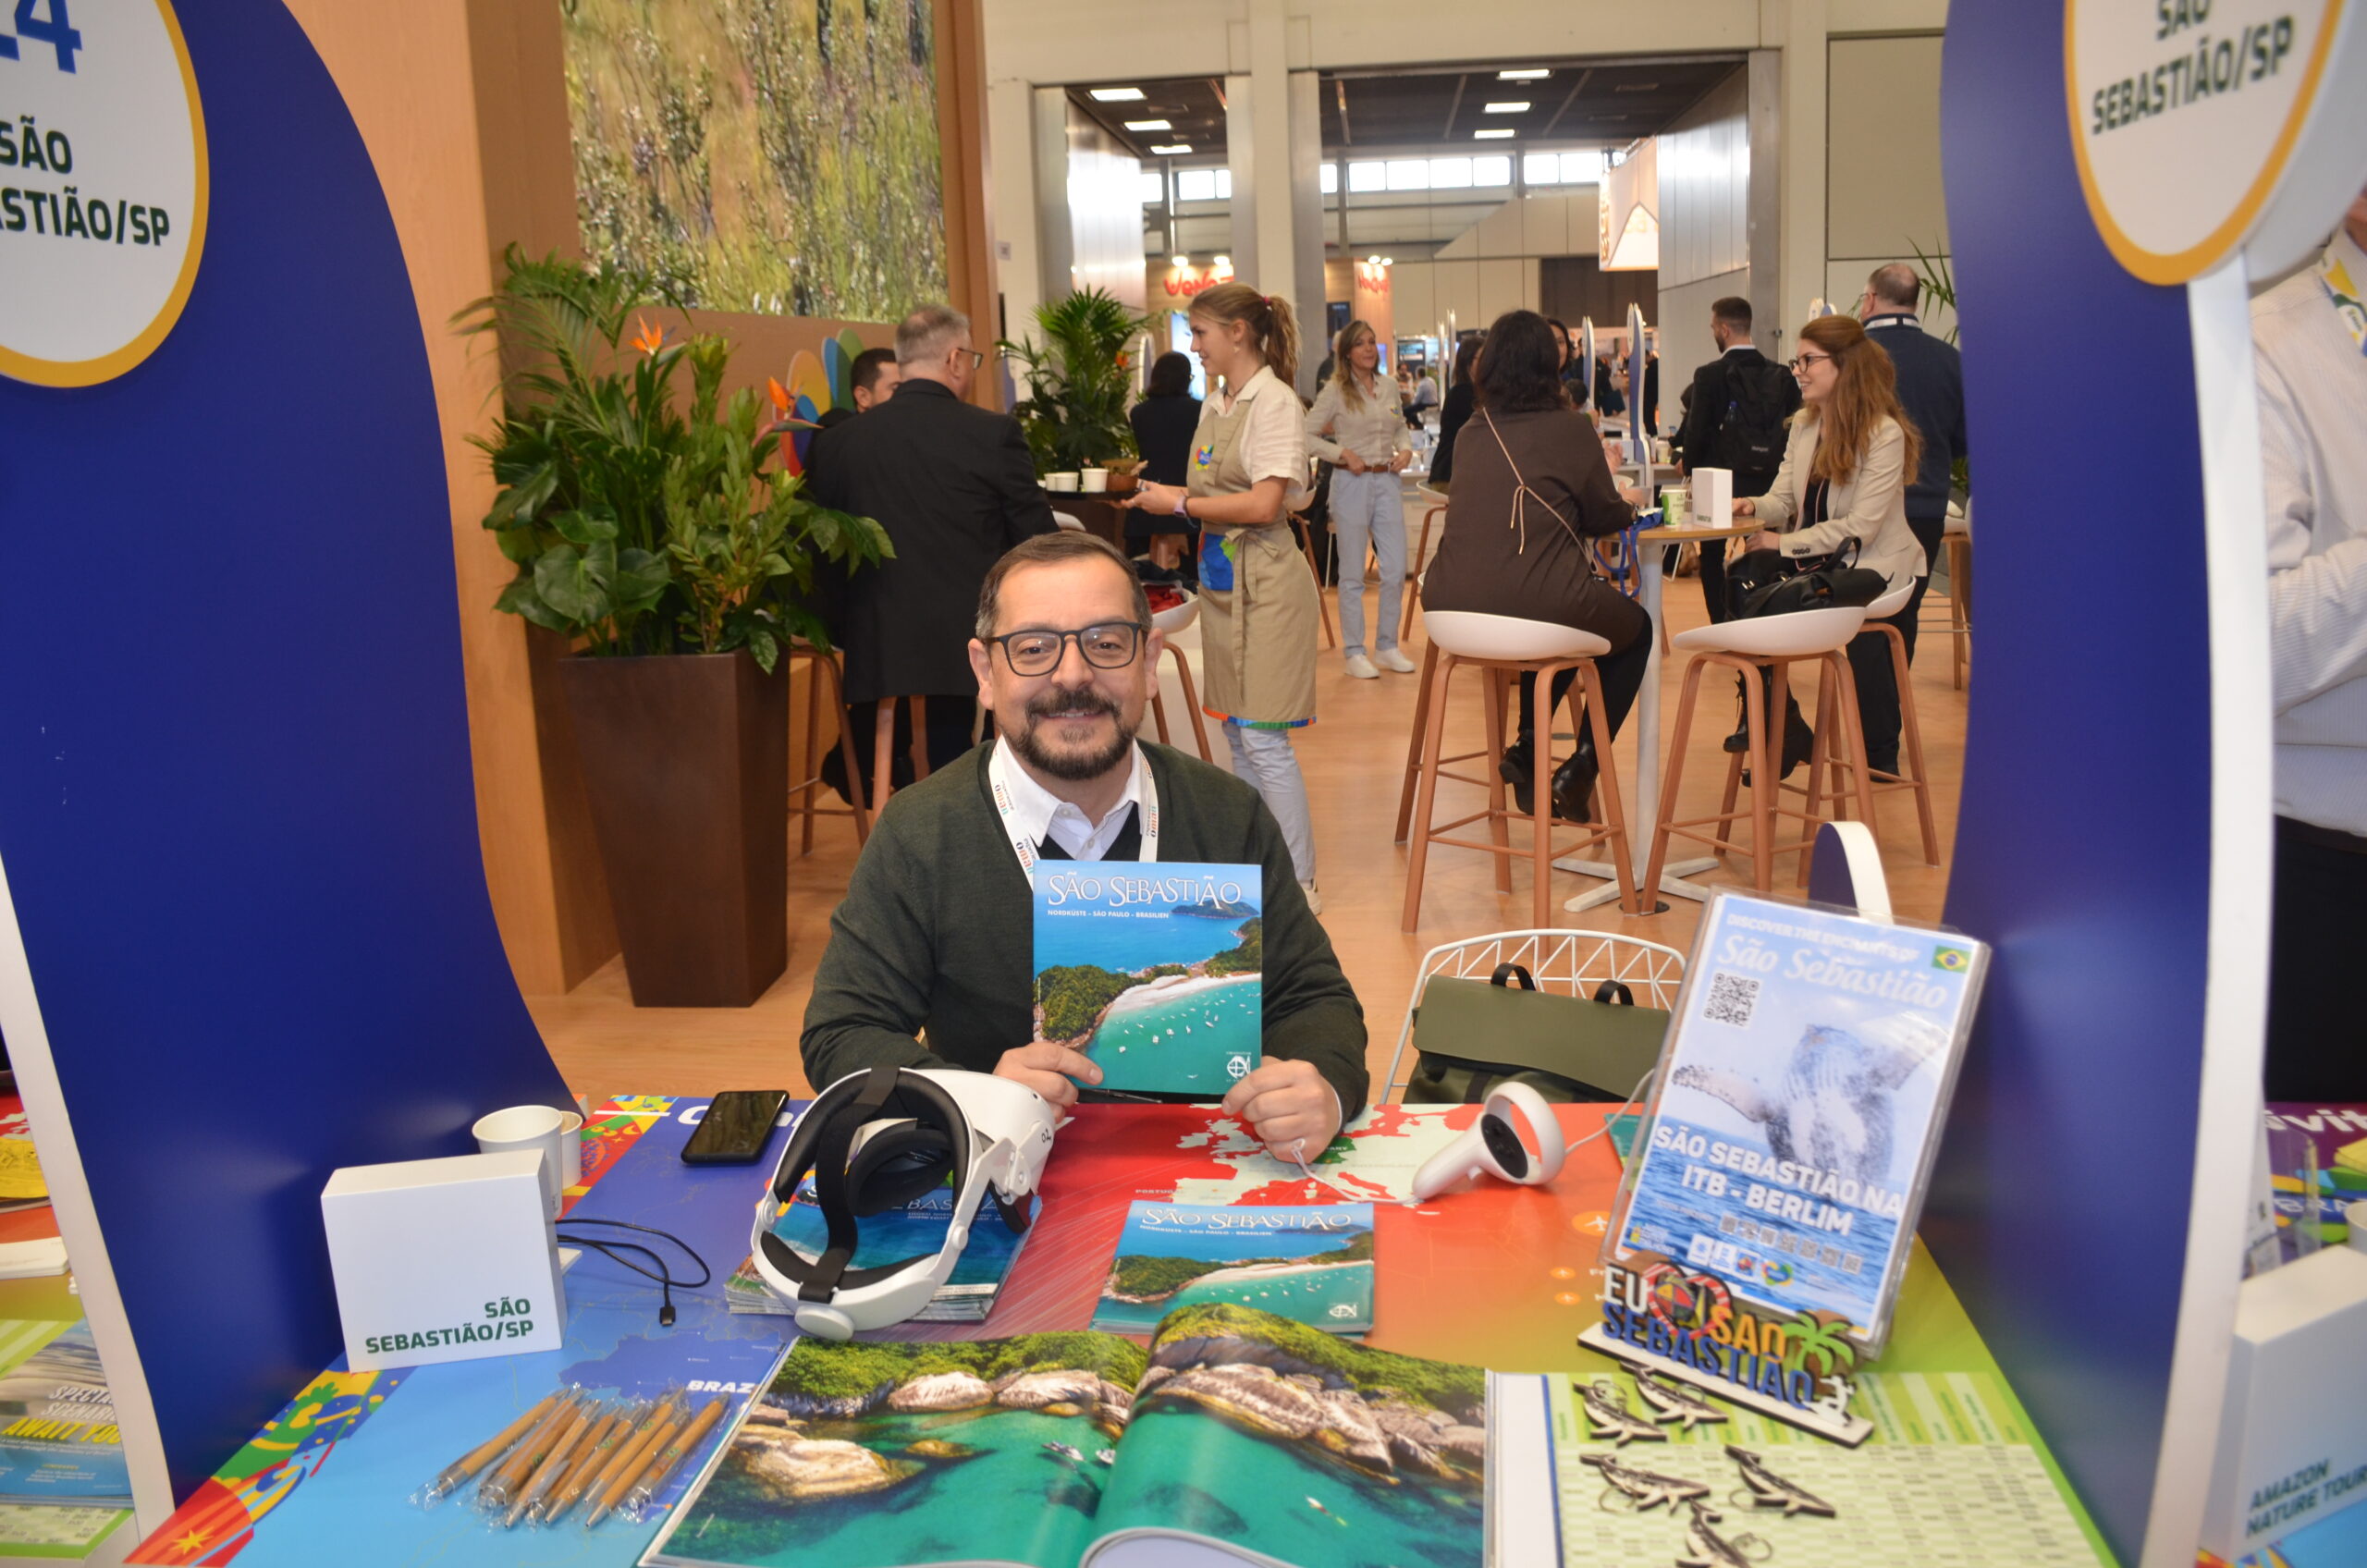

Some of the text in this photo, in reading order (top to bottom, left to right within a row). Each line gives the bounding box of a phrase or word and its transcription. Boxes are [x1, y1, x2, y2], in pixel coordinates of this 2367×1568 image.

[2091, 15, 2294, 135] SEBASTIÃO/SP
[0, 186, 170, 247] STIÃO/SP
[1048, 872, 1242, 910] SÃO SEBASTIÃO
[1717, 934, 1949, 1010] São Sebastião
[1654, 1124, 1905, 1219] SÃO SEBASTIÃO NA
[1142, 1207, 1353, 1231] SÃO SEBASTIÃO
[1681, 1164, 1728, 1198] ITB
[1744, 1183, 1855, 1237] BERLIM
[484, 1296, 532, 1318] SÃO
[1604, 1264, 1649, 1315] EU
[365, 1319, 533, 1354] SEBASTIÃO/SP
[49, 1386, 113, 1405] SPECTA
[686, 1379, 756, 1394] BRAZ
[2, 1416, 87, 1440] AWAIT
[2249, 1458, 2329, 1513] AMAZON
[2246, 1487, 2320, 1539] NATURE
